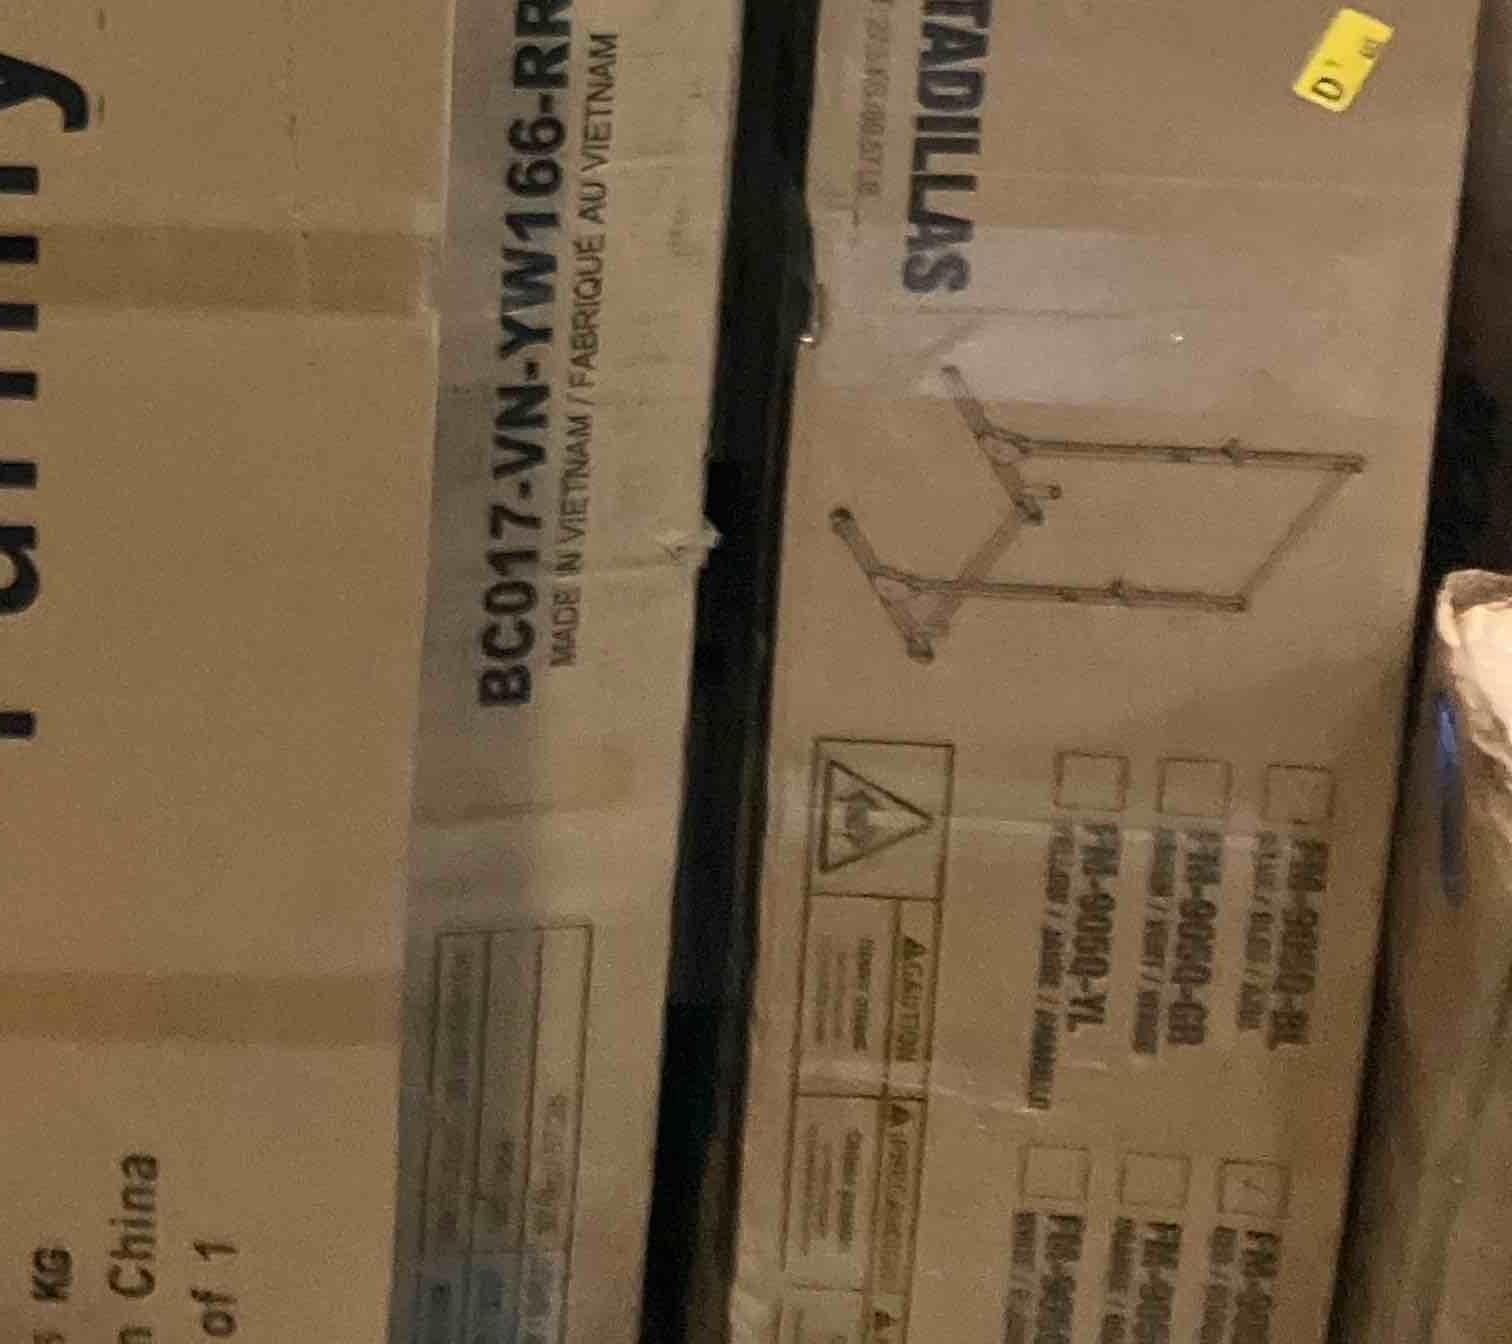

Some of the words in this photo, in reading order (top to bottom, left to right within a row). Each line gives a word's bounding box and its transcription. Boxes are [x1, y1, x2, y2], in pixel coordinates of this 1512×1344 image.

[581, 32, 620, 173] VIETNAM
[578, 181, 608, 225] AU
[559, 413, 594, 545] VIETNAM
[554, 549, 583, 577] IN
[549, 584, 582, 668] MADE
[106, 1152, 161, 1300] China
[191, 1239, 239, 1263] 1
[30, 1245, 73, 1304] KG
[189, 1286, 238, 1338] of
